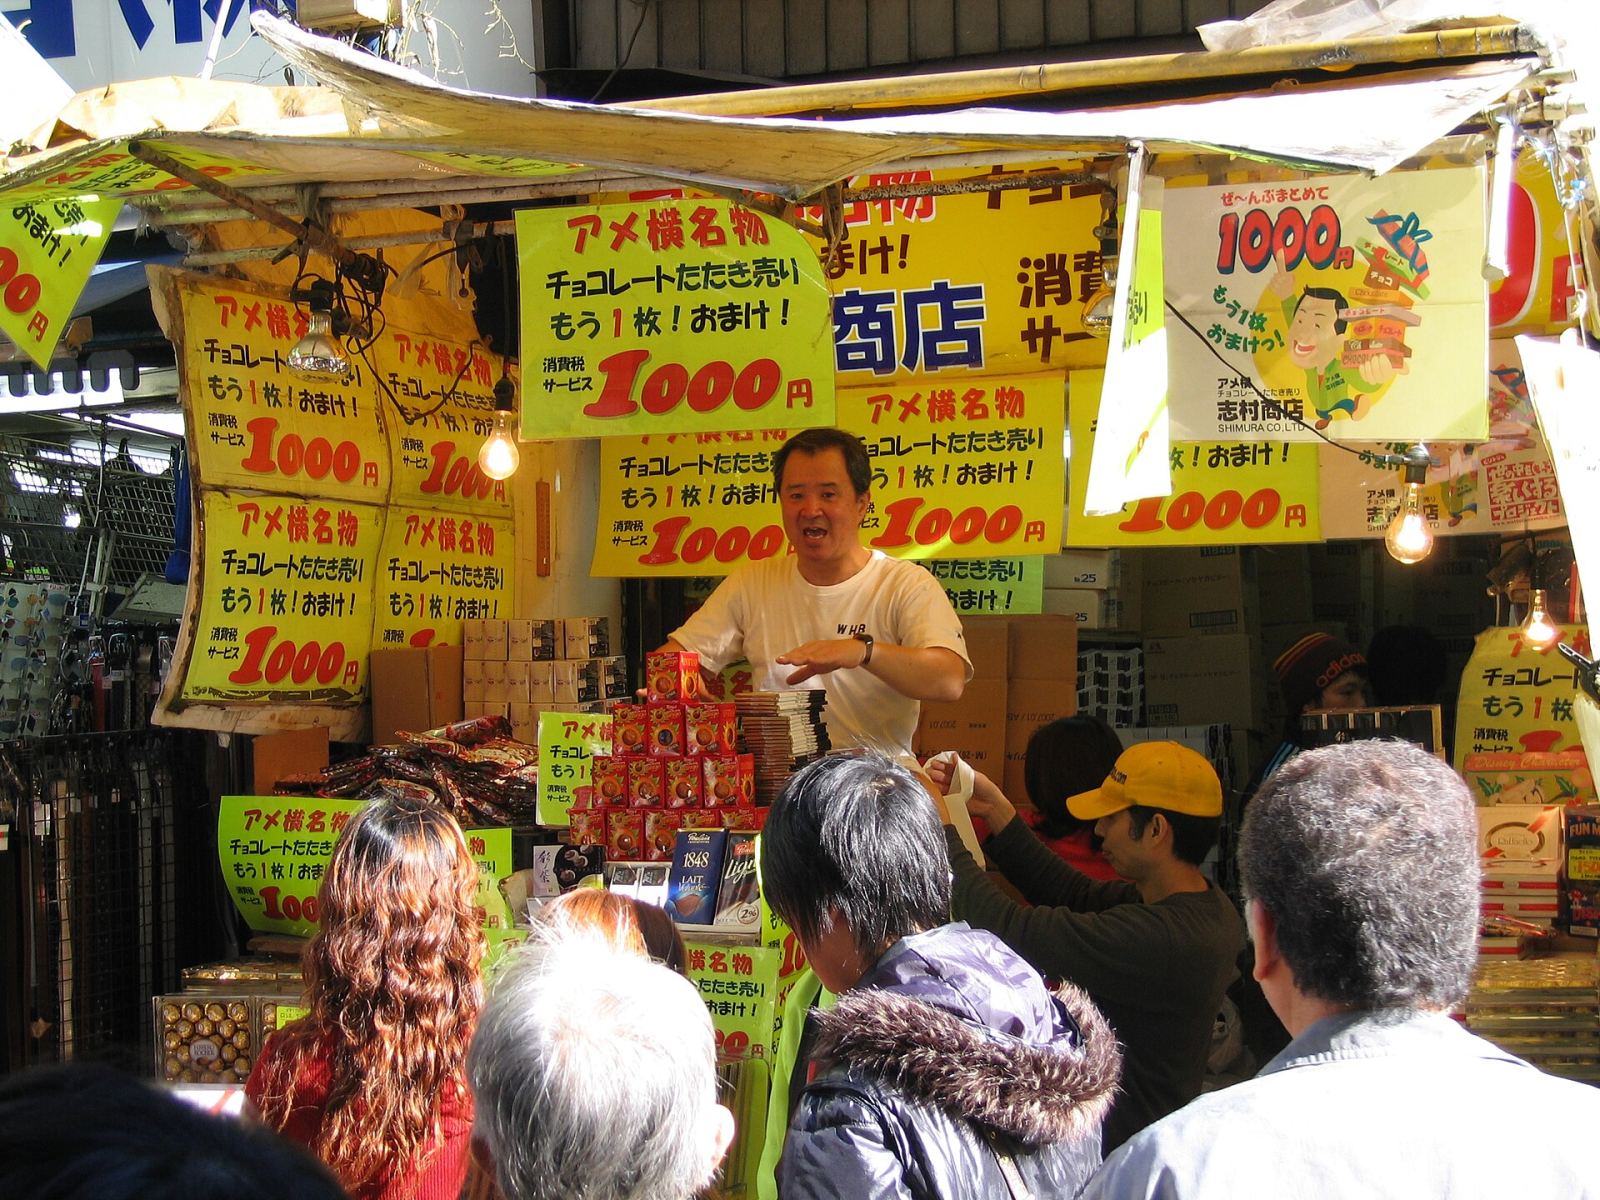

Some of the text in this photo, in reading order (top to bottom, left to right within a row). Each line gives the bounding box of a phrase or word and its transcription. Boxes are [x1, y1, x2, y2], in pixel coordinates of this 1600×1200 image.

[567, 205, 769, 254] アメ横名物
[1217, 204, 1354, 274] 1000円
[545, 257, 799, 300] チョコレートたたき売り
[214, 295, 311, 340] アメ横名
[393, 333, 493, 387] アメ横名物
[543, 356, 585, 373] 消費税
[543, 377, 593, 393] サービス
[583, 349, 813, 417] 1000円
[1217, 377, 1252, 389] アメ横
[866, 385, 1026, 425] アメ横名物
[1217, 399, 1304, 421] 志村商店
[208, 412, 238, 430] 消費税
[1218, 424, 1265, 433] SHIMURA
[210, 432, 245, 448] サービス
[401, 436, 424, 453] 消費税
[241, 417, 380, 487] 1000円
[402, 455, 429, 470] サービス
[237, 502, 359, 547] アメ横名物
[612, 520, 644, 532] 消費税
[870, 497, 1046, 548] 1000円
[403, 514, 496, 557] アメ横名物
[611, 535, 648, 548] サービス
[221, 549, 364, 582] チョコレートたたき売り
[388, 557, 504, 591] チョコレートたたき売り
[210, 626, 238, 642] 消費税
[383, 629, 405, 644] 消費税
[207, 645, 240, 660] サービス
[228, 625, 359, 686] 1000円
[1473, 727, 1509, 740] 消費税
[546, 795, 571, 803] サービス
[682, 851, 710, 868] 1848
[681, 875, 704, 884] LAIT
